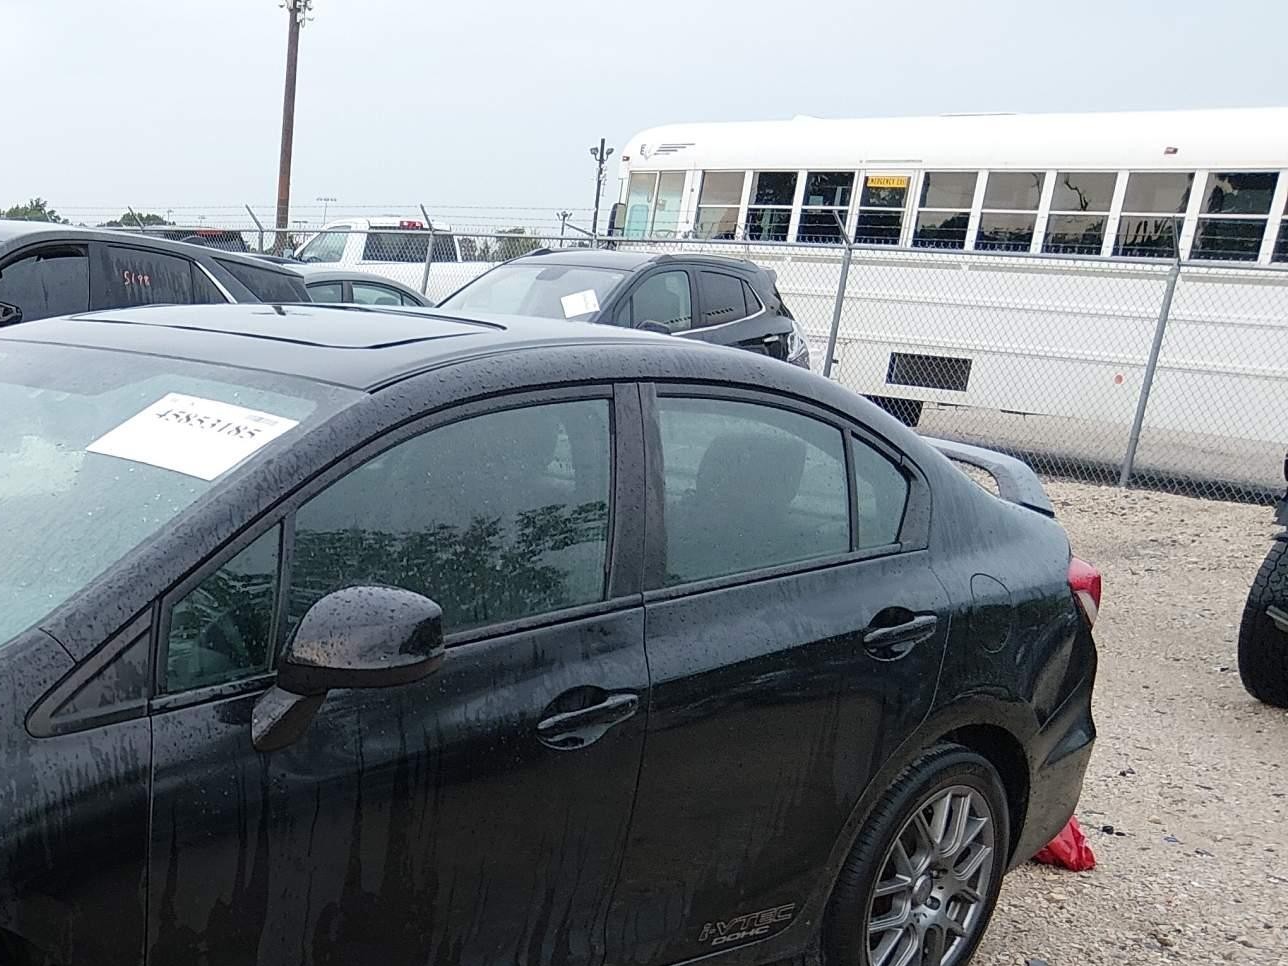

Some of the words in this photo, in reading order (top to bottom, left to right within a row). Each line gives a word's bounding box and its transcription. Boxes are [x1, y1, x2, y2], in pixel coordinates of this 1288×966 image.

[156, 408, 262, 439] 45853185
[698, 902, 795, 942] i-VTEC
[712, 925, 770, 946] DOHC
